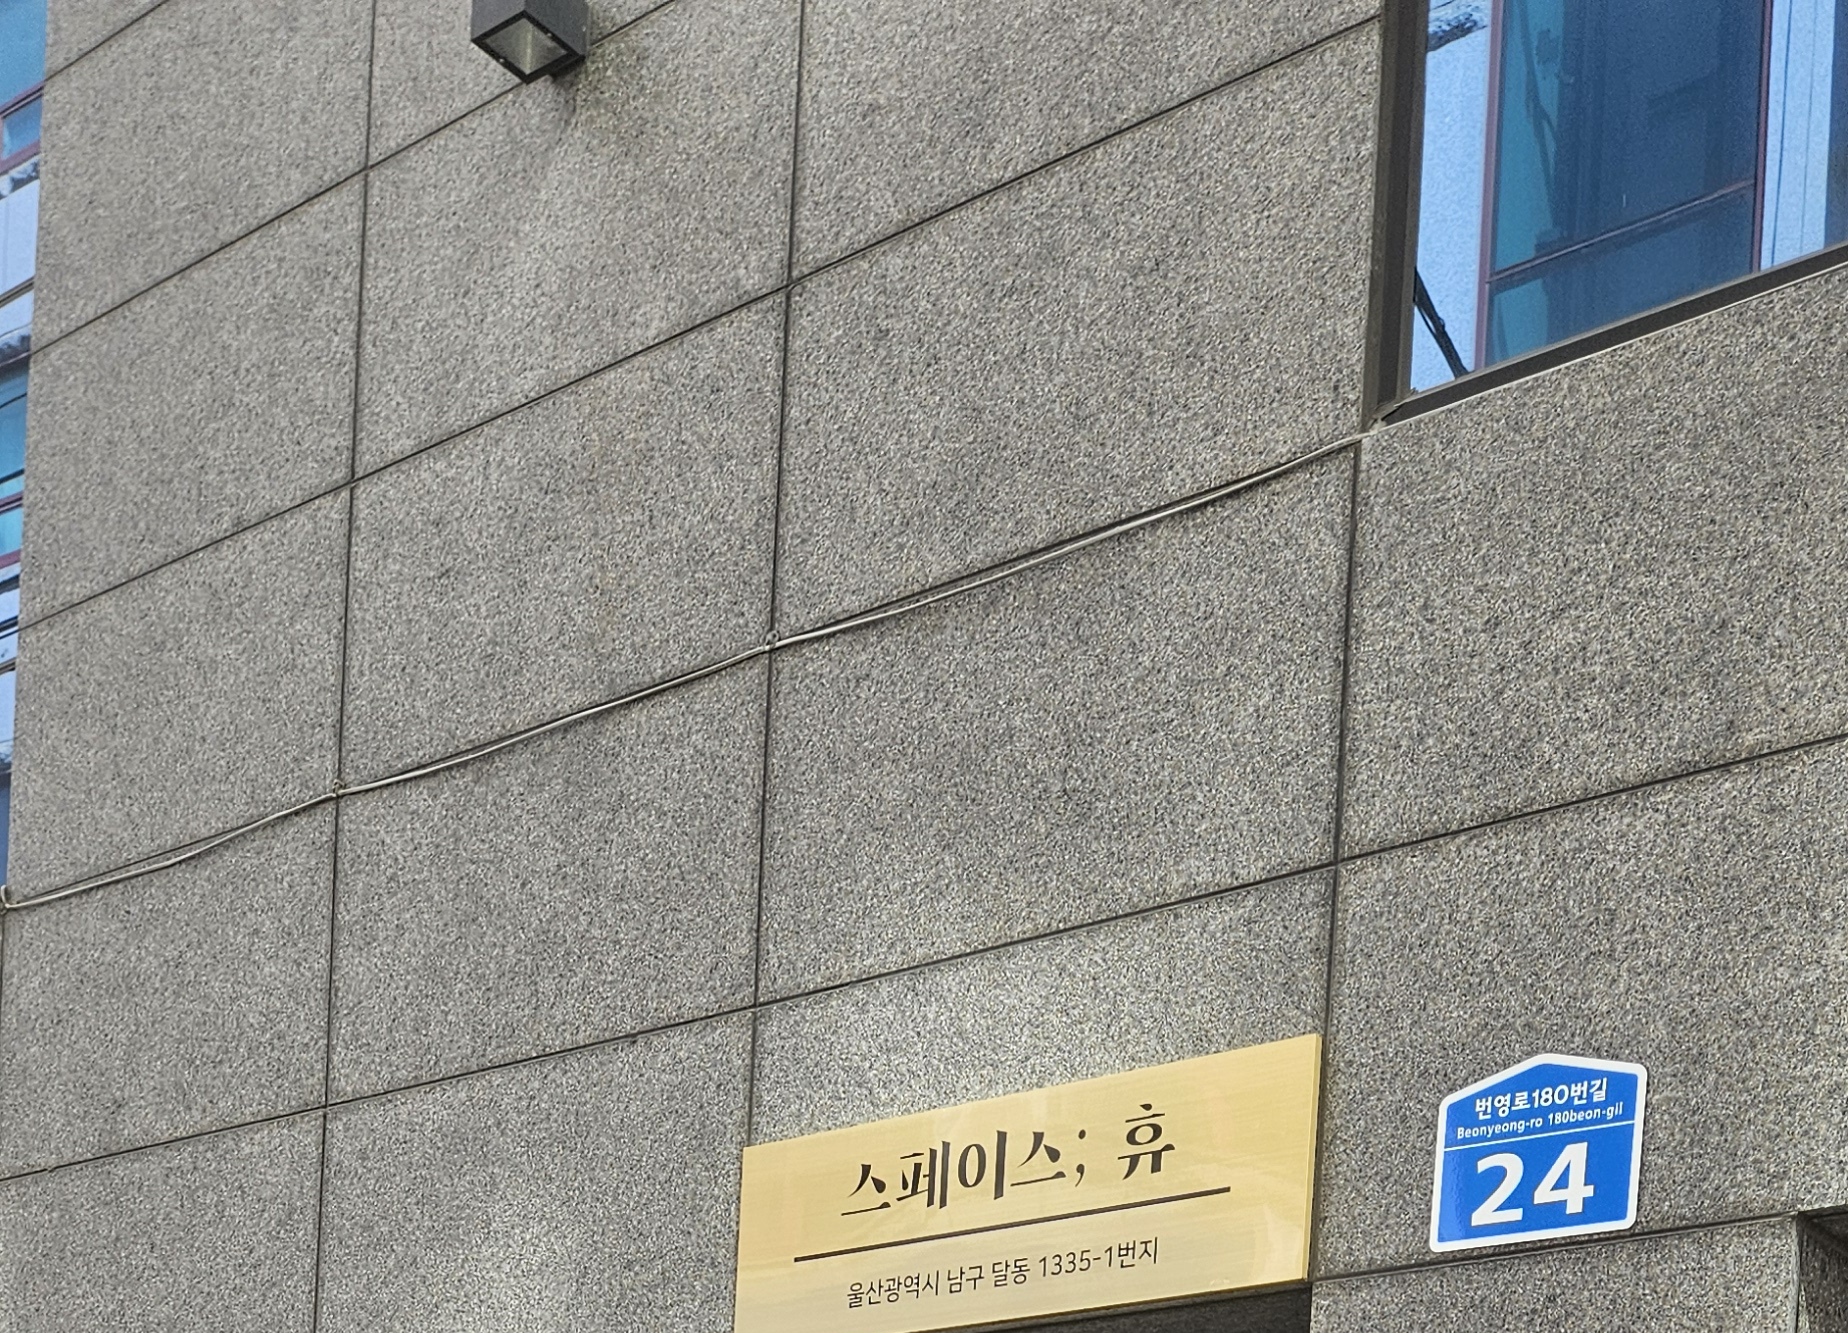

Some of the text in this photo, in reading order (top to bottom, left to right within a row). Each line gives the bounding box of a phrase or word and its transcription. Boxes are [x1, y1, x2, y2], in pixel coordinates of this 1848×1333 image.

[1456, 1101, 1624, 1140] Beonyeong-ro 180beon-gil
[1474, 1076, 1608, 1121] 번영로180번길
[841, 1103, 1176, 1217] 스페이스; 휴
[1470, 1141, 1595, 1227] 24
[846, 1236, 1158, 1309] 울산광역시 남구 달동 1335-1번지
